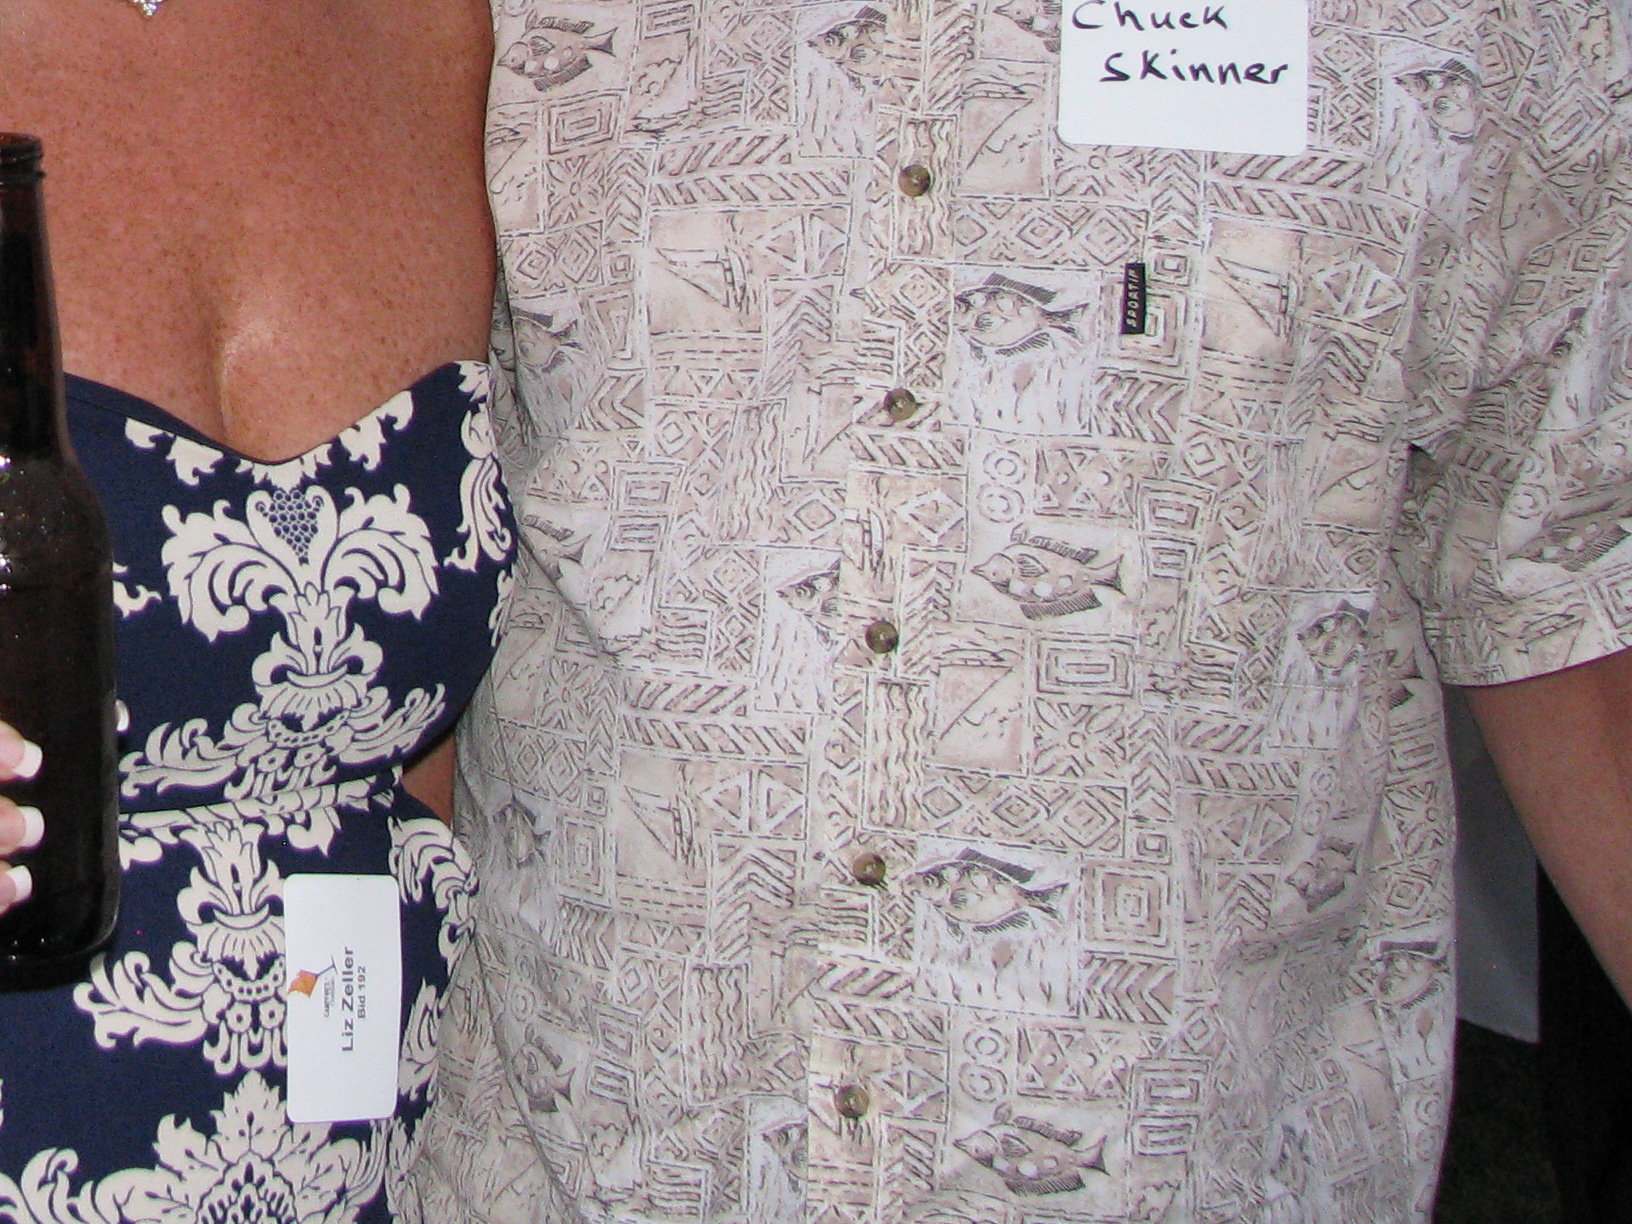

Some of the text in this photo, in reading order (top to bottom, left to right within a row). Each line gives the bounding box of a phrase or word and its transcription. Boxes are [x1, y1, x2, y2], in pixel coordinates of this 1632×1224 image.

[1072, 0, 1228, 31] Chuck
[341, 945, 354, 1052] Liz Zeller
[358, 965, 366, 1019] Bid 192
